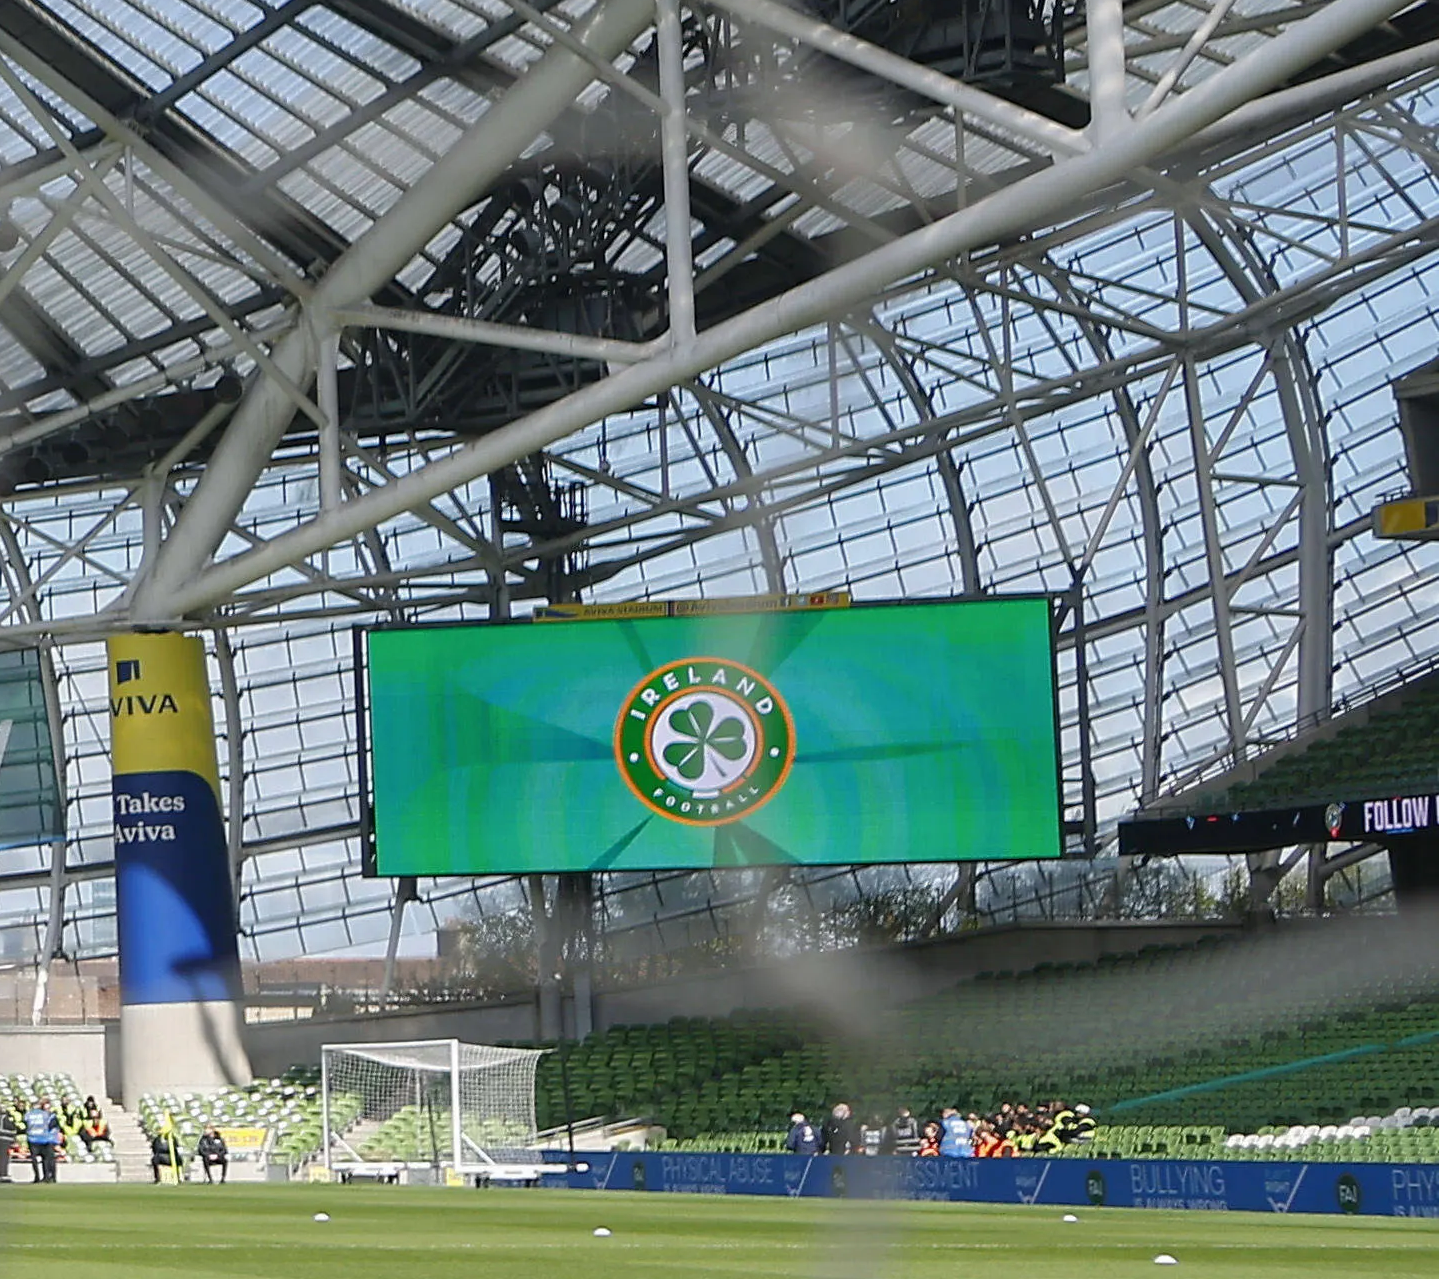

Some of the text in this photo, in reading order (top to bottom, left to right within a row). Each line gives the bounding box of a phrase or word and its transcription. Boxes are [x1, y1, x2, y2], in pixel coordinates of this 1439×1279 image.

[110, 695, 179, 717] VIVA
[630, 666, 774, 721] IRELAND
[116, 791, 185, 815] Takes
[653, 786, 759, 815] FOOTBALL
[1364, 796, 1430, 833] FOLLOW
[1130, 1164, 1225, 1195] BULLYING
